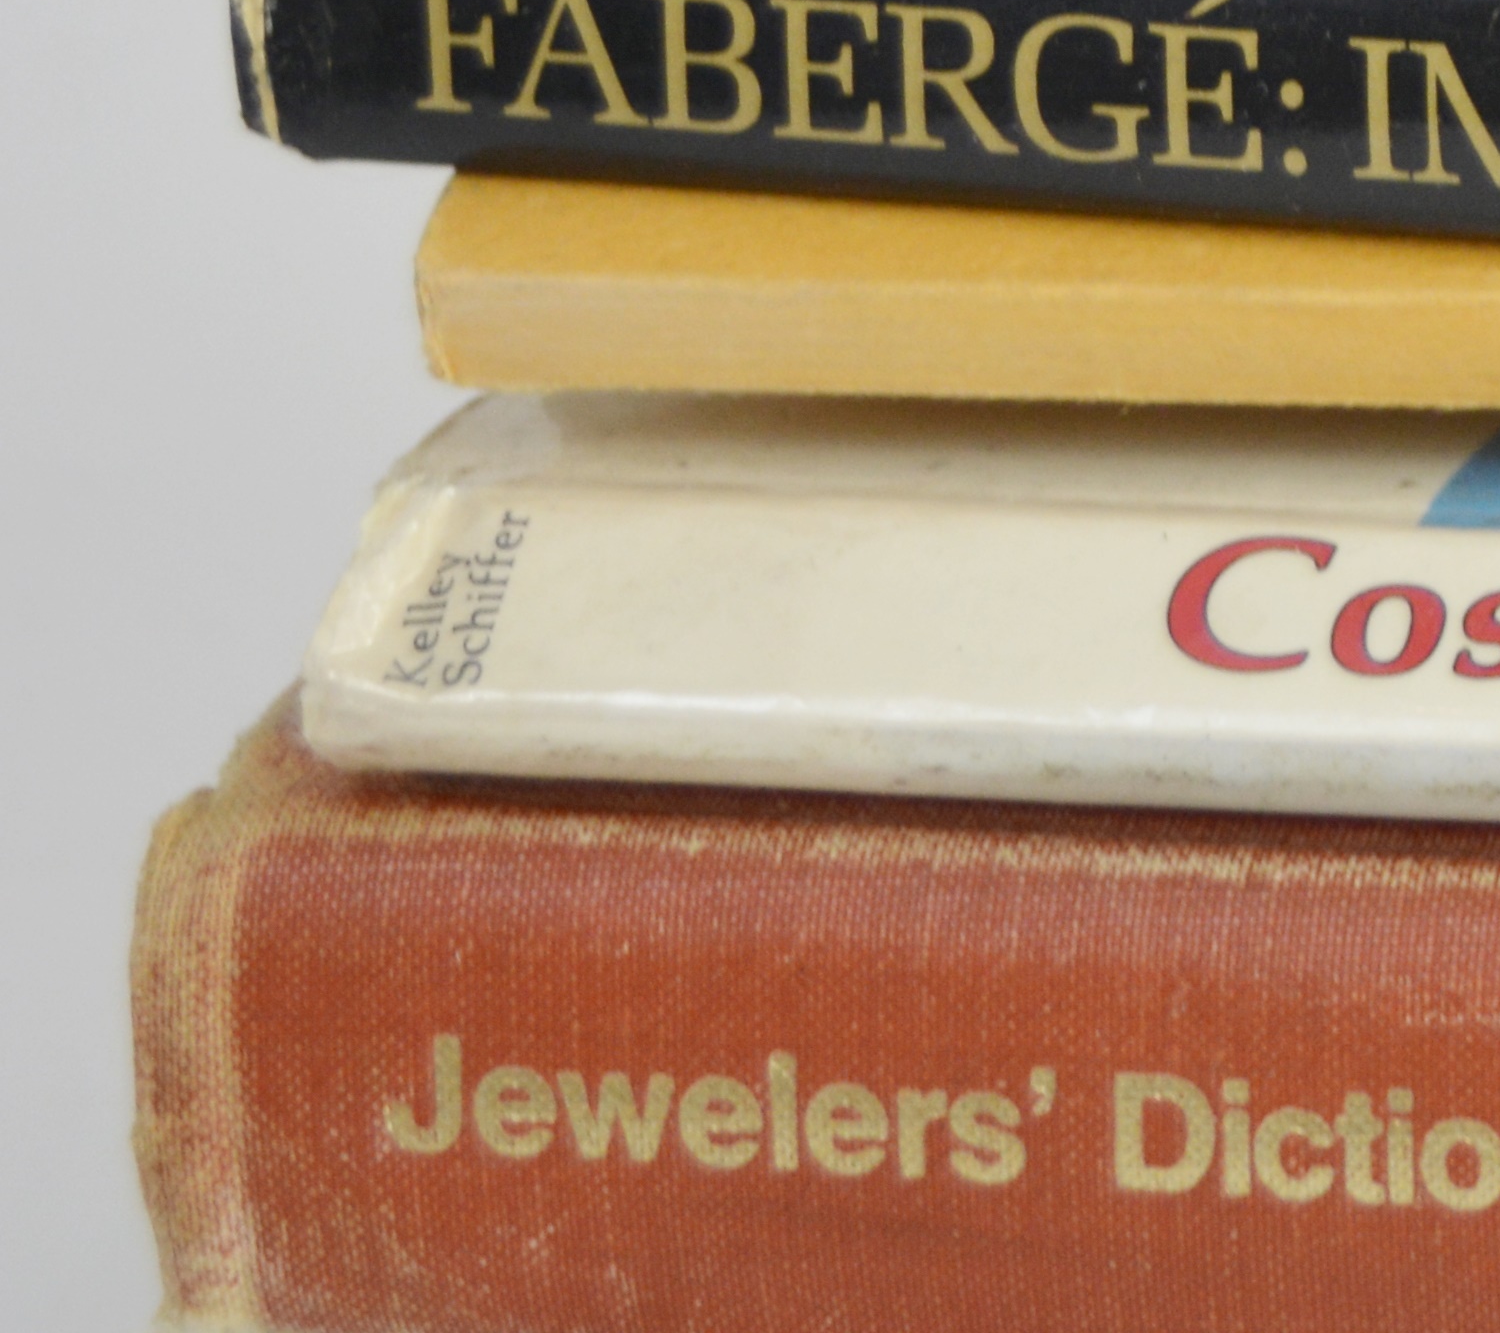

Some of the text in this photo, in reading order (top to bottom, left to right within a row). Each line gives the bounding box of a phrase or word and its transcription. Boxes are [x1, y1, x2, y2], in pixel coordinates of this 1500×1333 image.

[383, 551, 474, 687] Kelley
[441, 510, 531, 687] Schiffer
[383, 1032, 1057, 1187] Jewelers'
